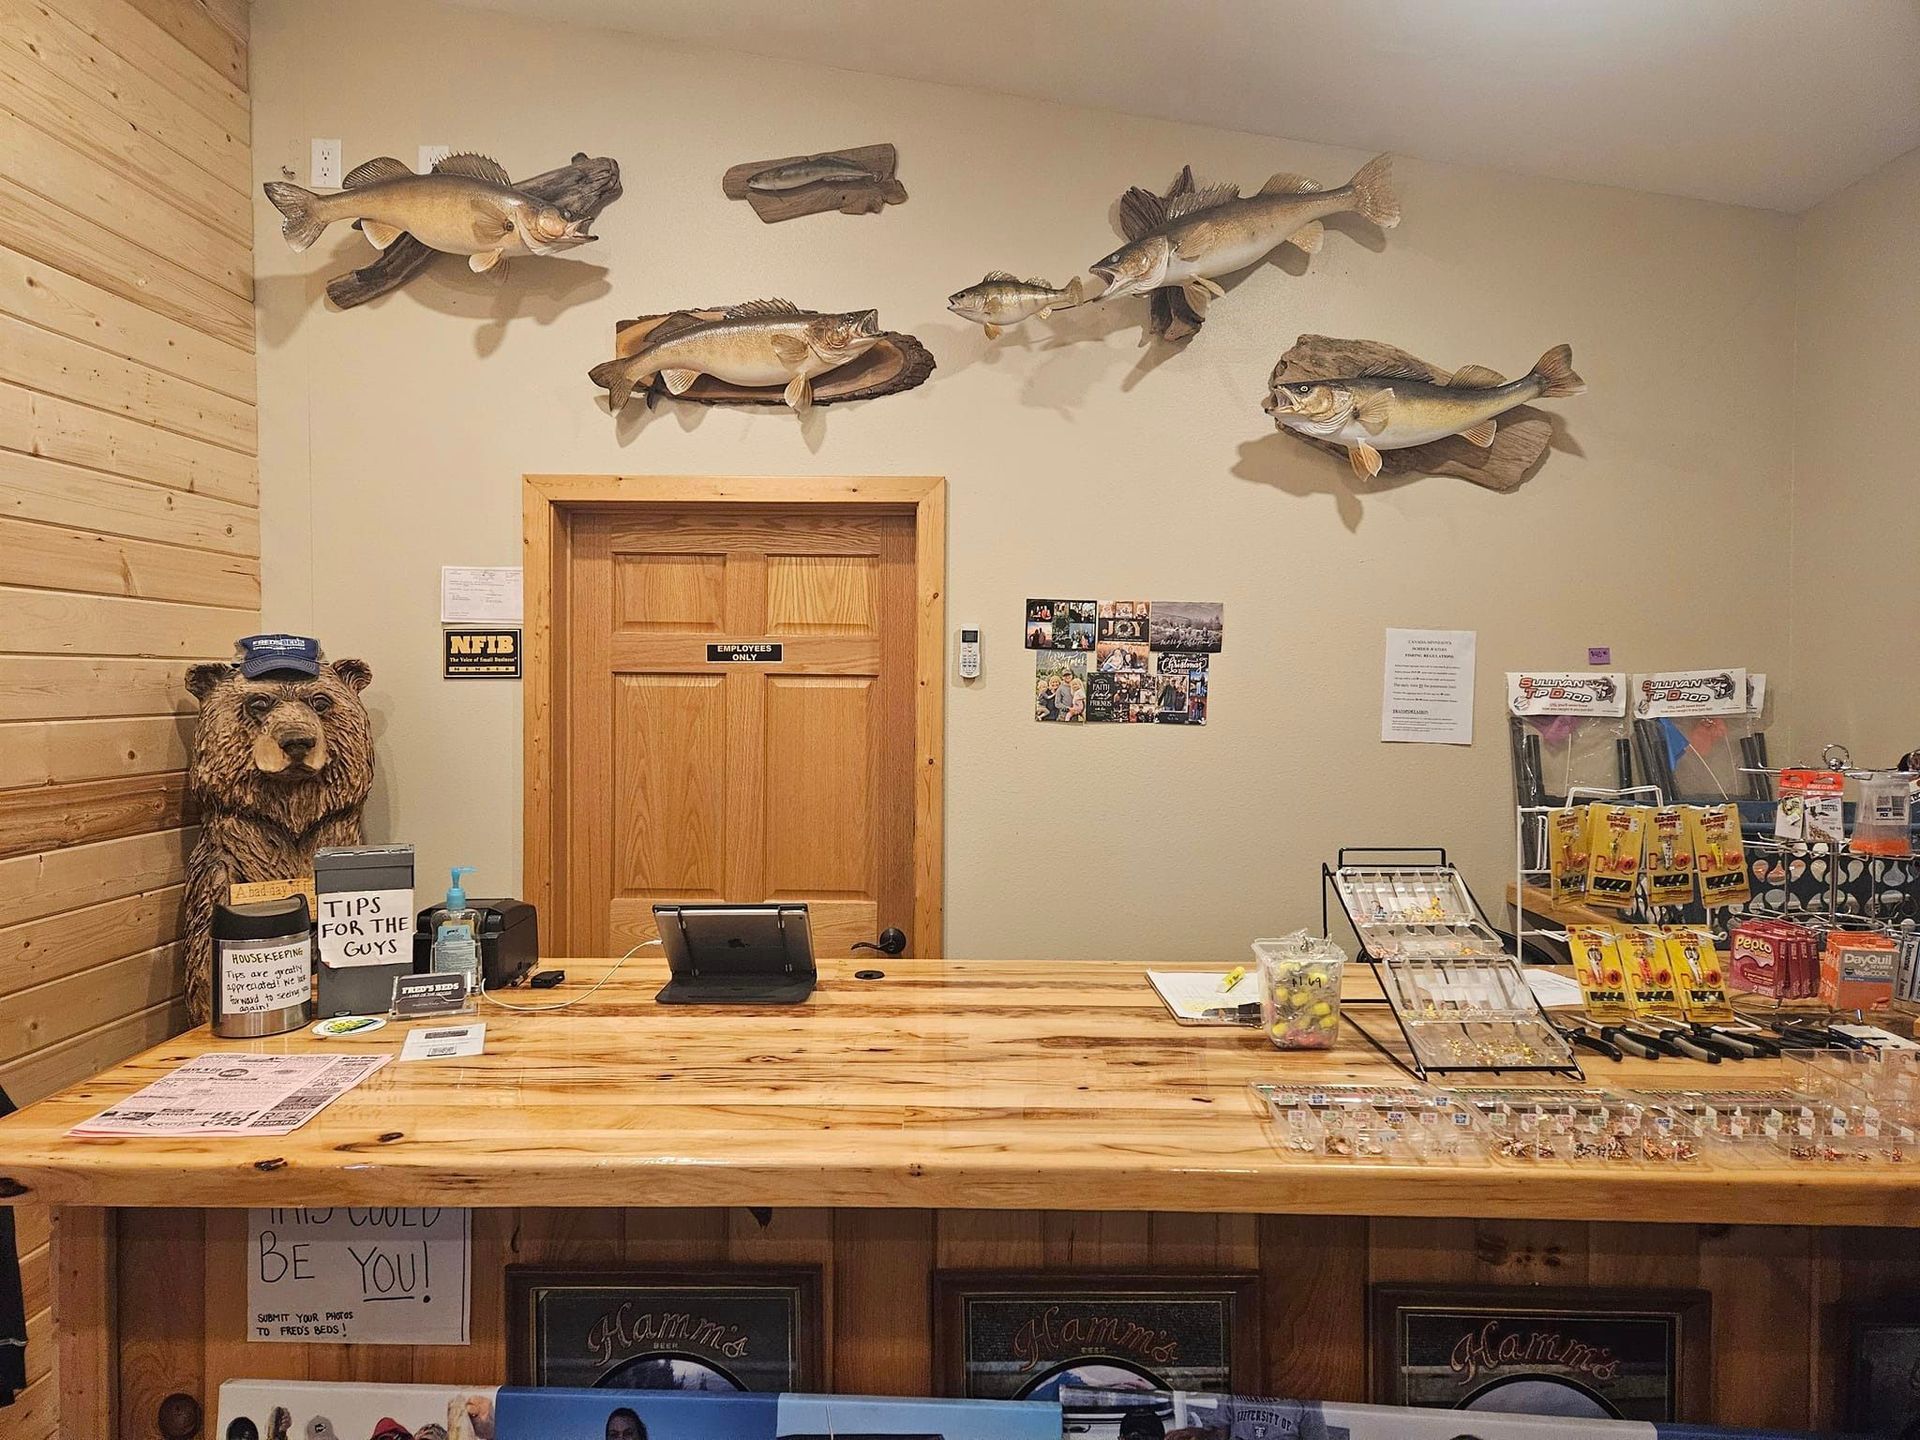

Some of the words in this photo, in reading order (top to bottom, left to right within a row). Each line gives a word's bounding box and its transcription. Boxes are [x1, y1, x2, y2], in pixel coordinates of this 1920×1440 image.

[450, 635, 514, 654] NFIB
[717, 645, 772, 653] EMPLOYEES
[732, 653, 757, 661] ONLY
[323, 896, 381, 918] TIPS
[322, 920, 364, 938] FOR
[369, 917, 408, 933] THE
[232, 947, 304, 964] HOUSEKEEPING
[344, 939, 397, 957] GUYS
[1844, 953, 1893, 967] DayQuil
[227, 970, 246, 981] Tips
[250, 970, 269, 978] are
[274, 964, 303, 980] greatly
[227, 980, 281, 993] appreciated!
[401, 984, 434, 995] FRED'S
[435, 982, 460, 992] BEDS
[1752, 984, 1758, 993] 2
[264, 993, 274, 1002] to
[239, 1002, 270, 1014] again!
[259, 1230, 315, 1283] BE
[348, 1240, 431, 1303] YOU!
[257, 1313, 289, 1323] SUBMIT
[296, 1313, 319, 1322] YOUR
[326, 1311, 354, 1320] PHOTOS
[256, 1327, 270, 1337] TO
[280, 1325, 310, 1336] FRED'S
[587, 1302, 749, 1367] Hamm's
[1014, 1305, 1179, 1372] Hamm's
[653, 1342, 679, 1350] BEER
[1450, 1320, 1621, 1386] Hamm's
